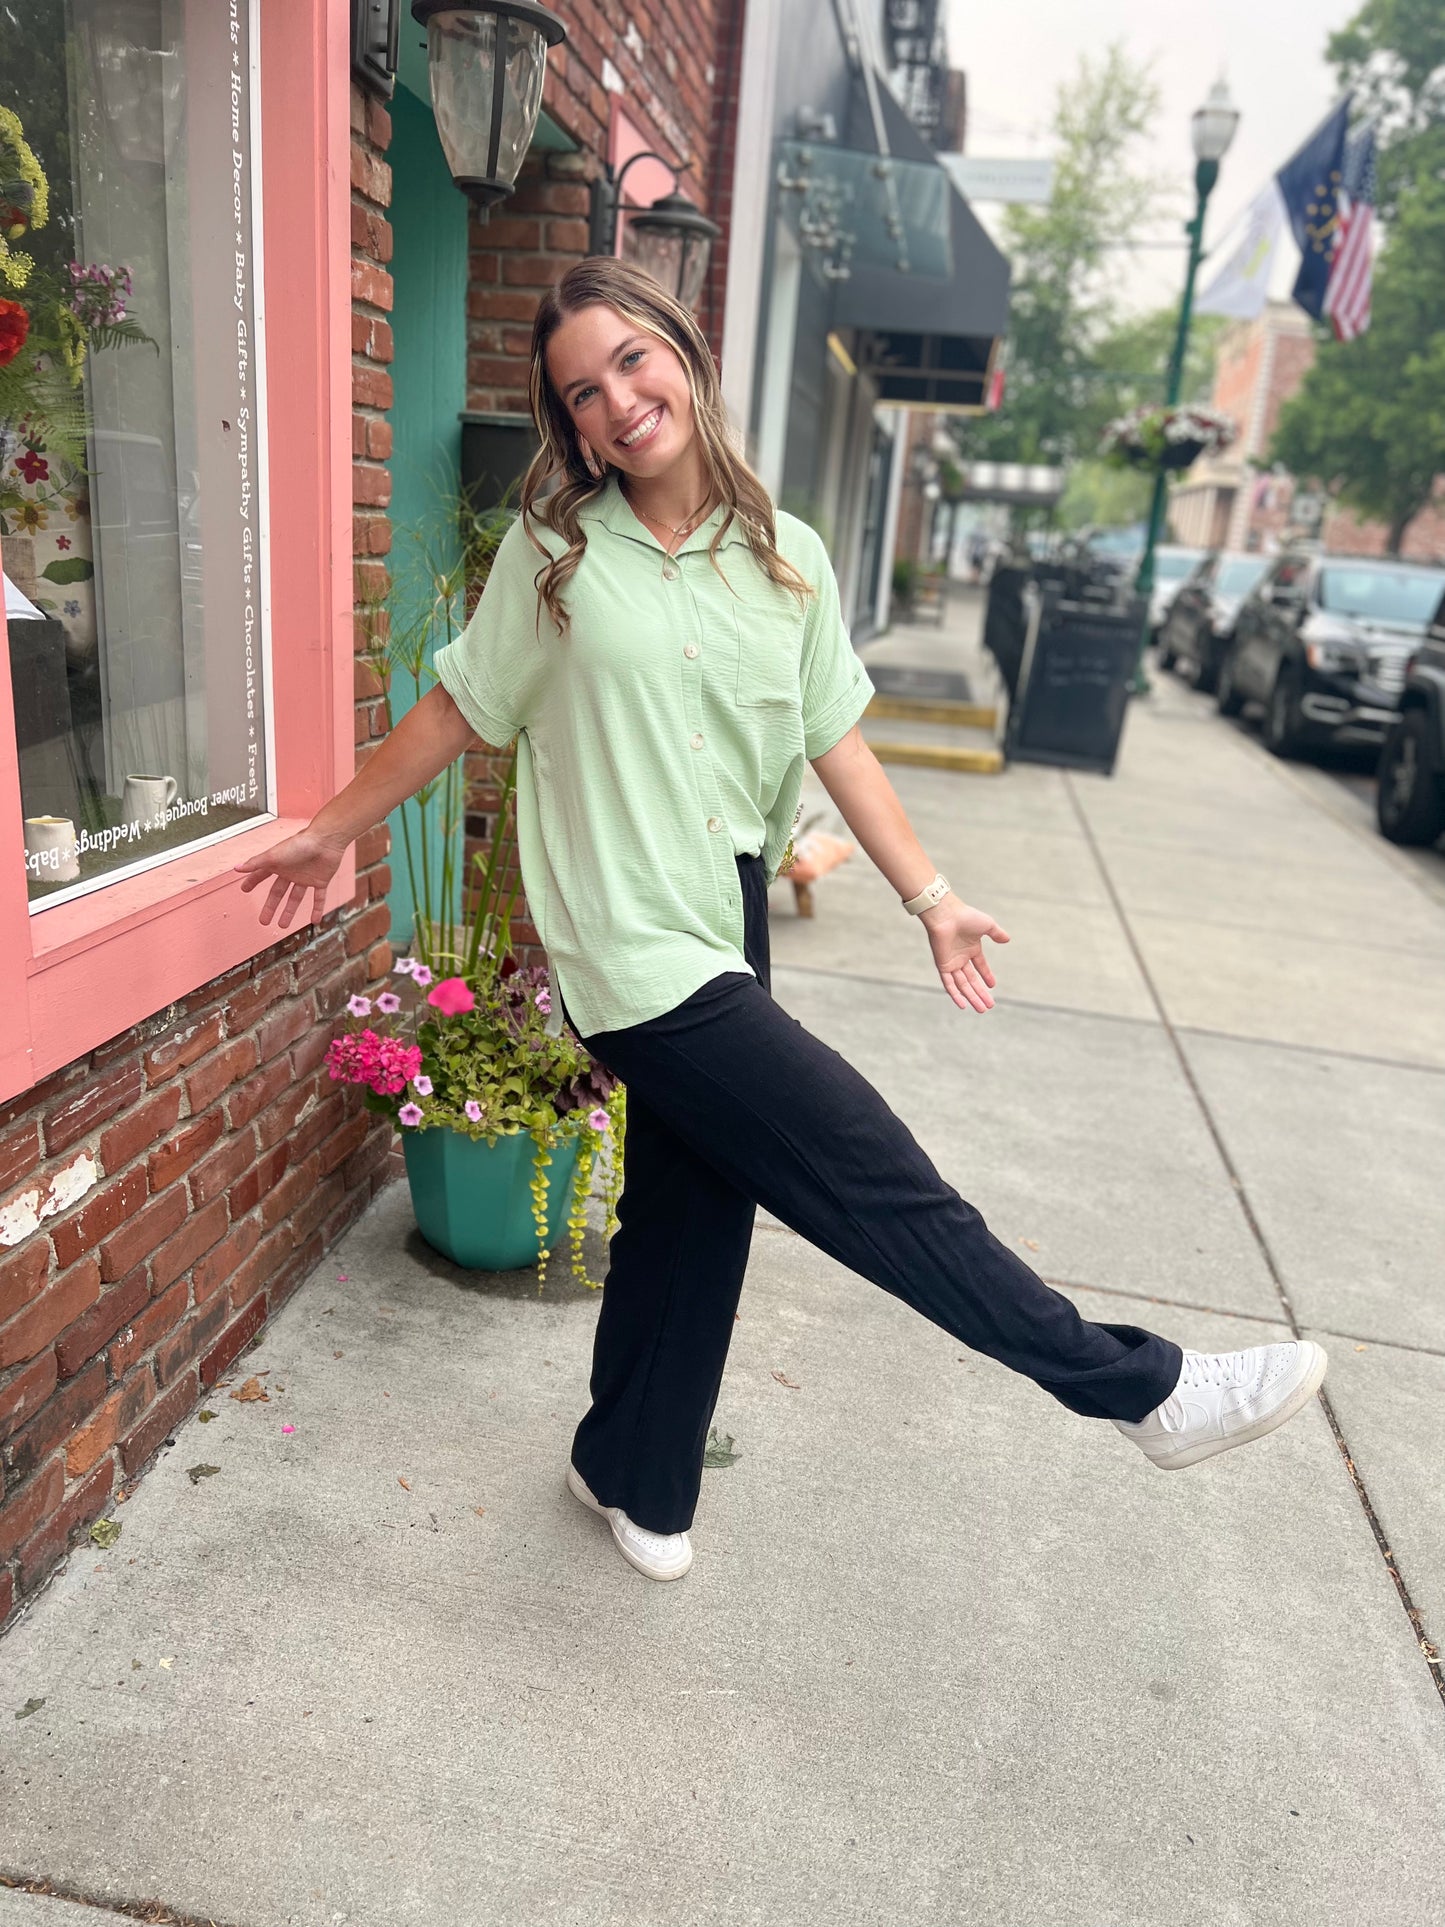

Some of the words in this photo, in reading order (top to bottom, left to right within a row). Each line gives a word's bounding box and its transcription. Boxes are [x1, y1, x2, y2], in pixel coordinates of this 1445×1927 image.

[230, 0, 240, 44] nts
[231, 71, 241, 142] Home
[232, 150, 242, 224] Decor
[234, 251, 245, 311] Baby
[237, 319, 248, 381] Gifts
[238, 407, 251, 519] Sympathy
[243, 527, 252, 583] Gifts
[244, 605, 256, 719] Chocolates
[210, 783, 246, 806] Flower
[248, 743, 258, 799] Fresh
[74, 820, 141, 854] Weddings
[154, 796, 208, 830] Bouquets
